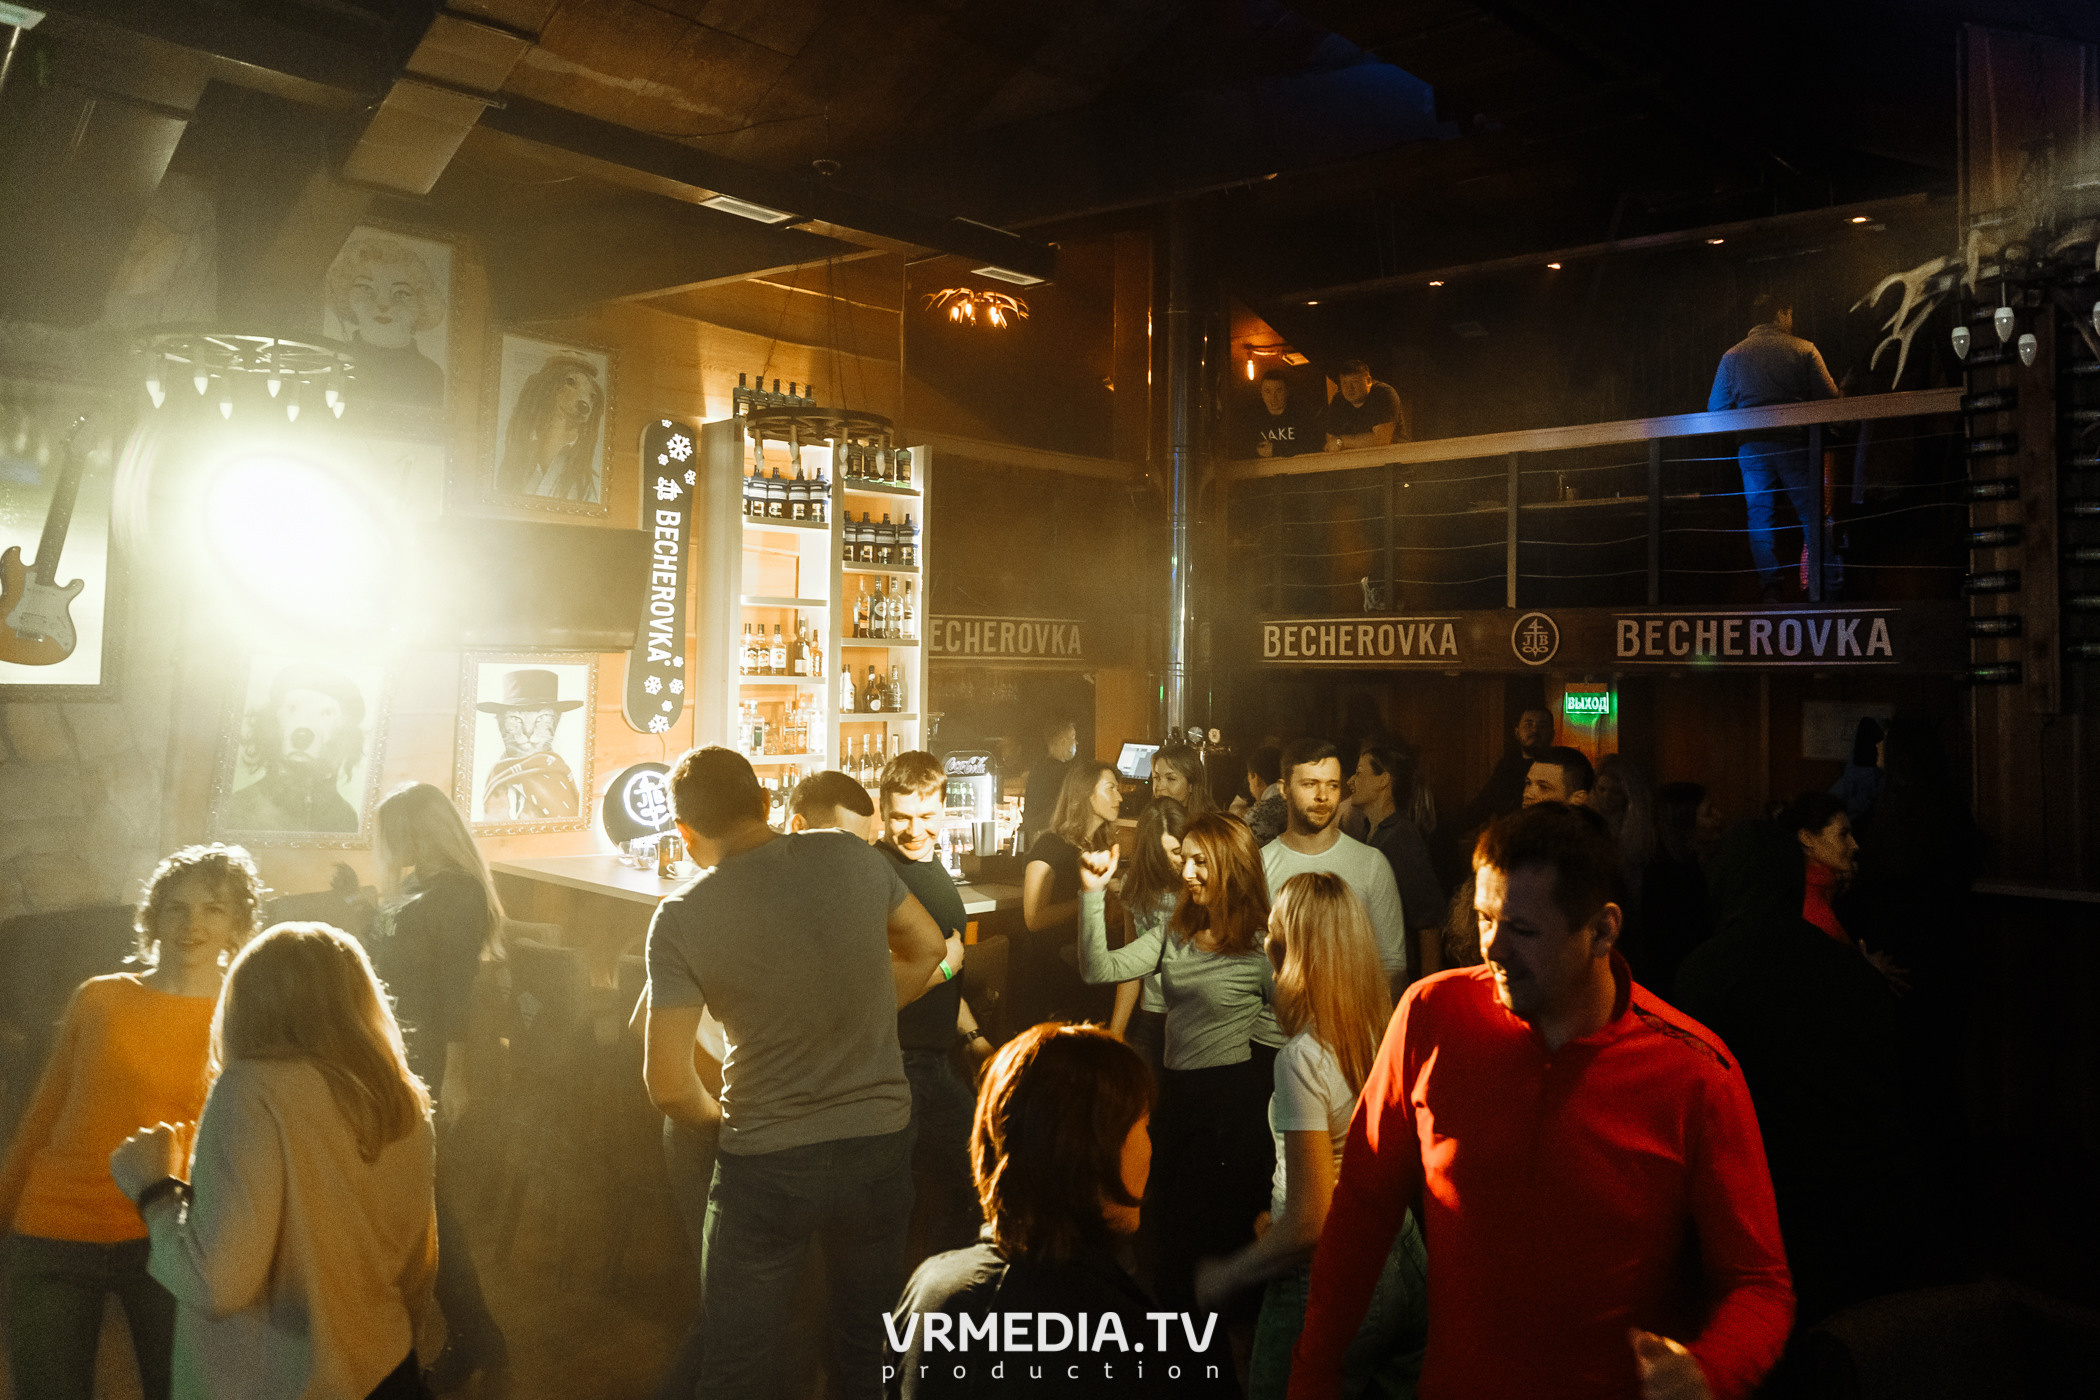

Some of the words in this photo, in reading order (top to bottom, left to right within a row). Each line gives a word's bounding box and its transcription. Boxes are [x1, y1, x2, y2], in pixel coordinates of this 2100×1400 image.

[647, 509, 682, 662] BECHEROVKA
[929, 619, 1082, 655] ECHEROVKA
[1263, 623, 1459, 658] BECHEROVKA
[1616, 618, 1893, 657] BECHEROVKA
[1567, 697, 1608, 713] ВЫХОД
